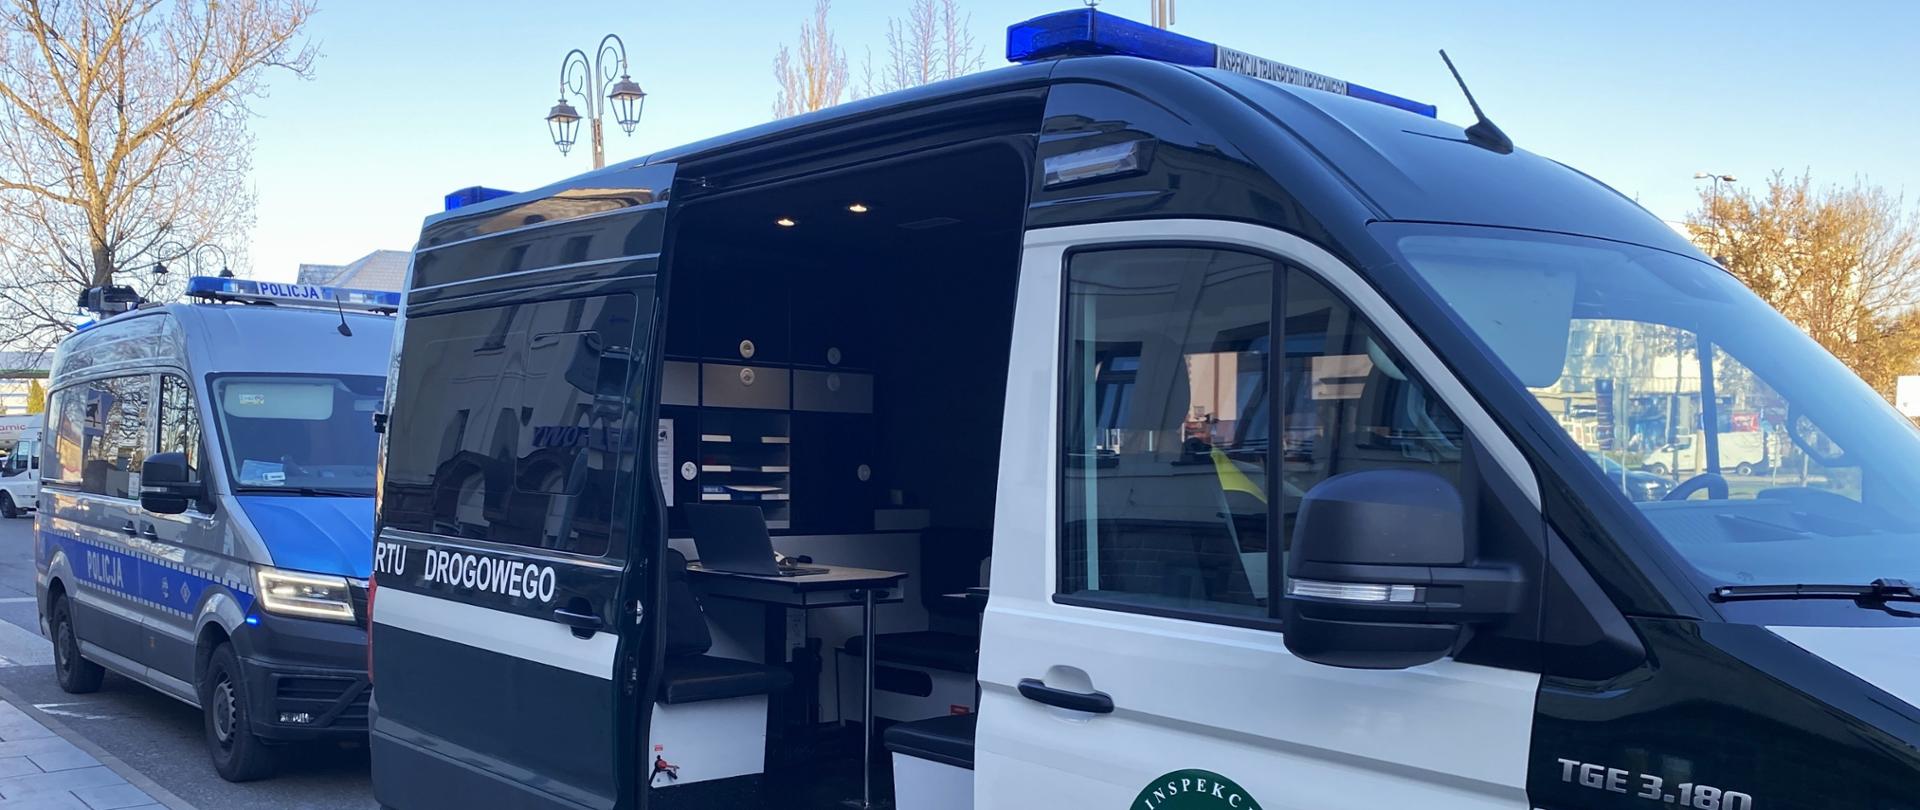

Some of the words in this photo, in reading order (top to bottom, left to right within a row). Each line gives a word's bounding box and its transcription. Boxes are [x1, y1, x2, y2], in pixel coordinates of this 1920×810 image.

[1219, 49, 1257, 77] INSPEKCJA
[260, 282, 319, 299] POLICJA
[87, 550, 124, 589] POLICJA
[374, 542, 407, 576] RTU
[424, 549, 556, 602] DROGOWEGO
[1145, 778, 1253, 810] INSPEKC
[1558, 758, 1629, 794] TGE
[1638, 773, 1752, 810] 3.180
